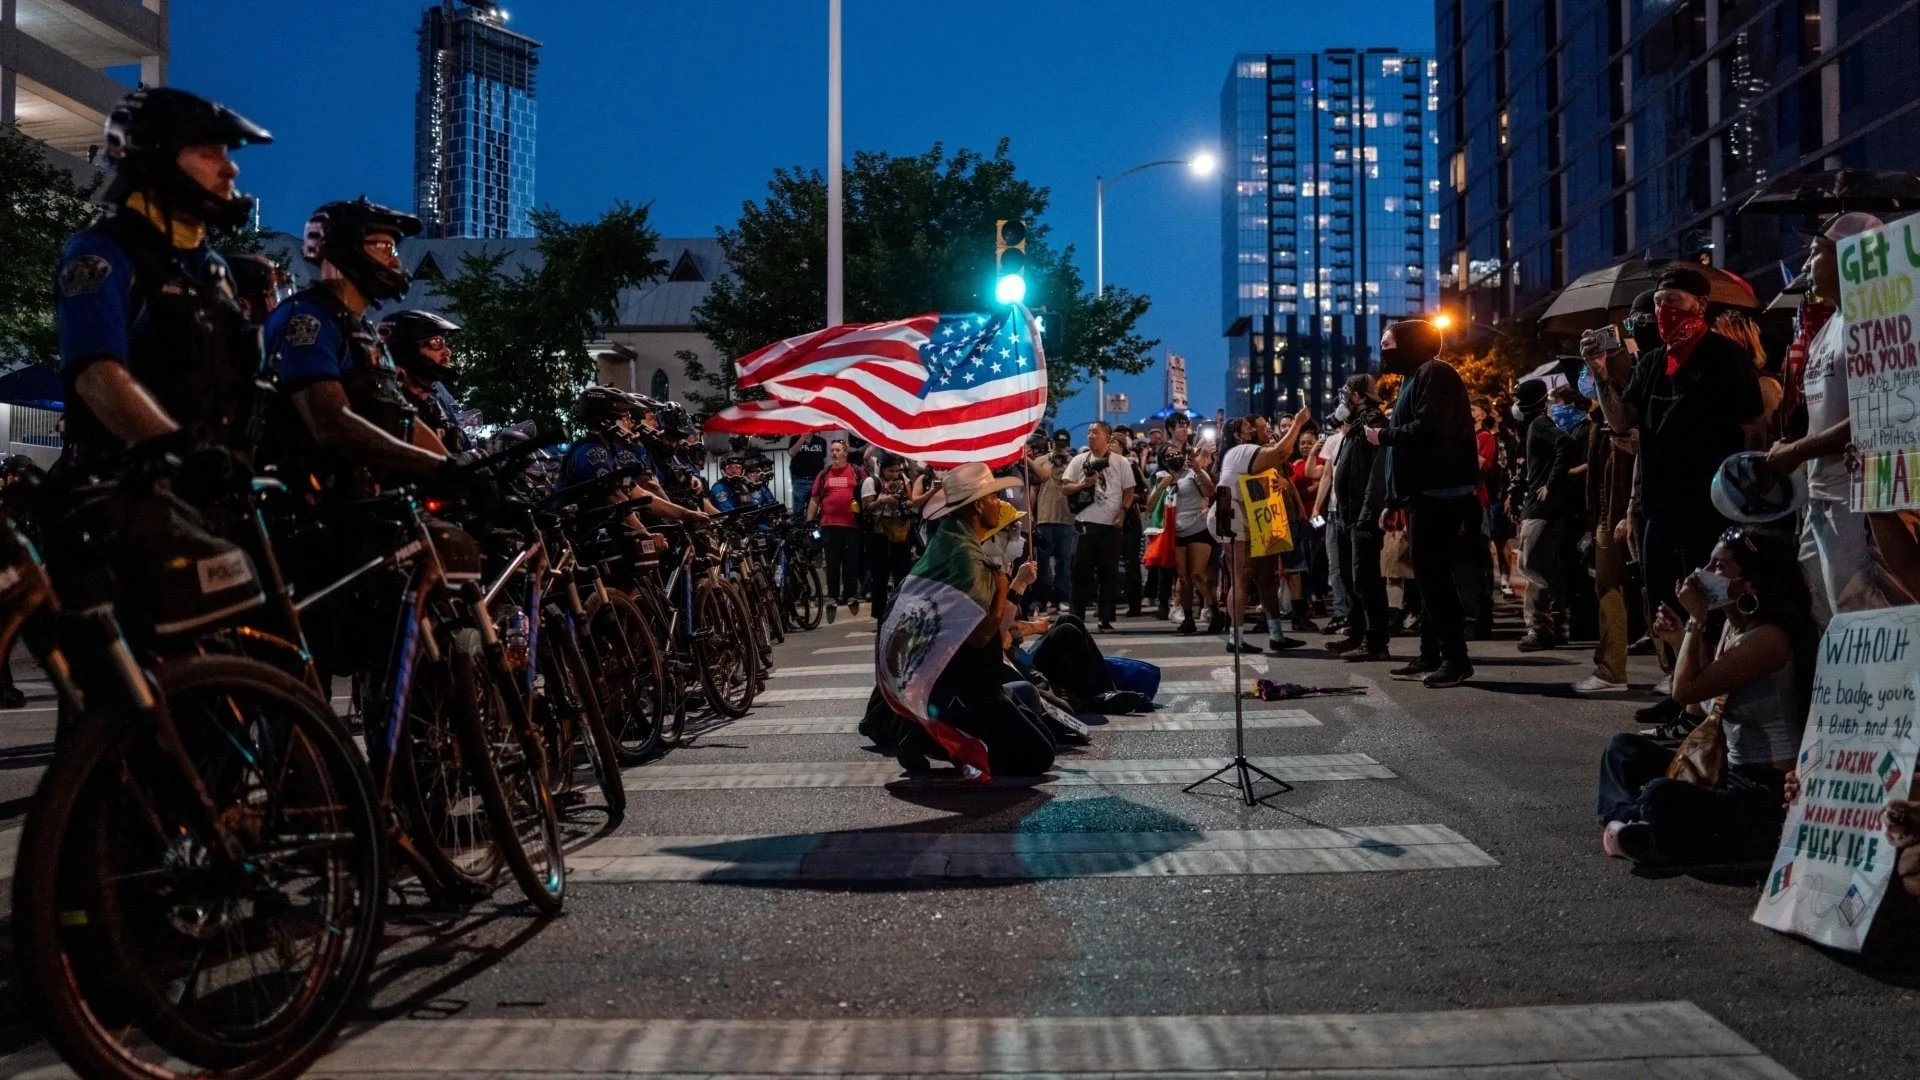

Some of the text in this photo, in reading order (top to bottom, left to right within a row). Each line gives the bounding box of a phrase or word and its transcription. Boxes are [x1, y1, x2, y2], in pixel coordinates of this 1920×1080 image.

[1843, 274, 1913, 322] STAND
[1847, 314, 1912, 355] STAND
[1847, 352, 1875, 380] FOR
[1878, 343, 1918, 373] YOUR
[1850, 387, 1916, 429] THIS
[800, 444, 823, 452] PRESS
[1253, 503, 1281, 533] FOR
[1812, 674, 1831, 705] the
[1835, 680, 1873, 713] badge
[1816, 715, 1823, 733] A
[1893, 714, 1913, 740] 1/2
[1825, 749, 1878, 774] I DRINK
[1805, 778, 1884, 803] MY TEQUILA
[1804, 804, 1884, 832] WARM BECAUS
[1794, 823, 1879, 872] FUCK ICE
